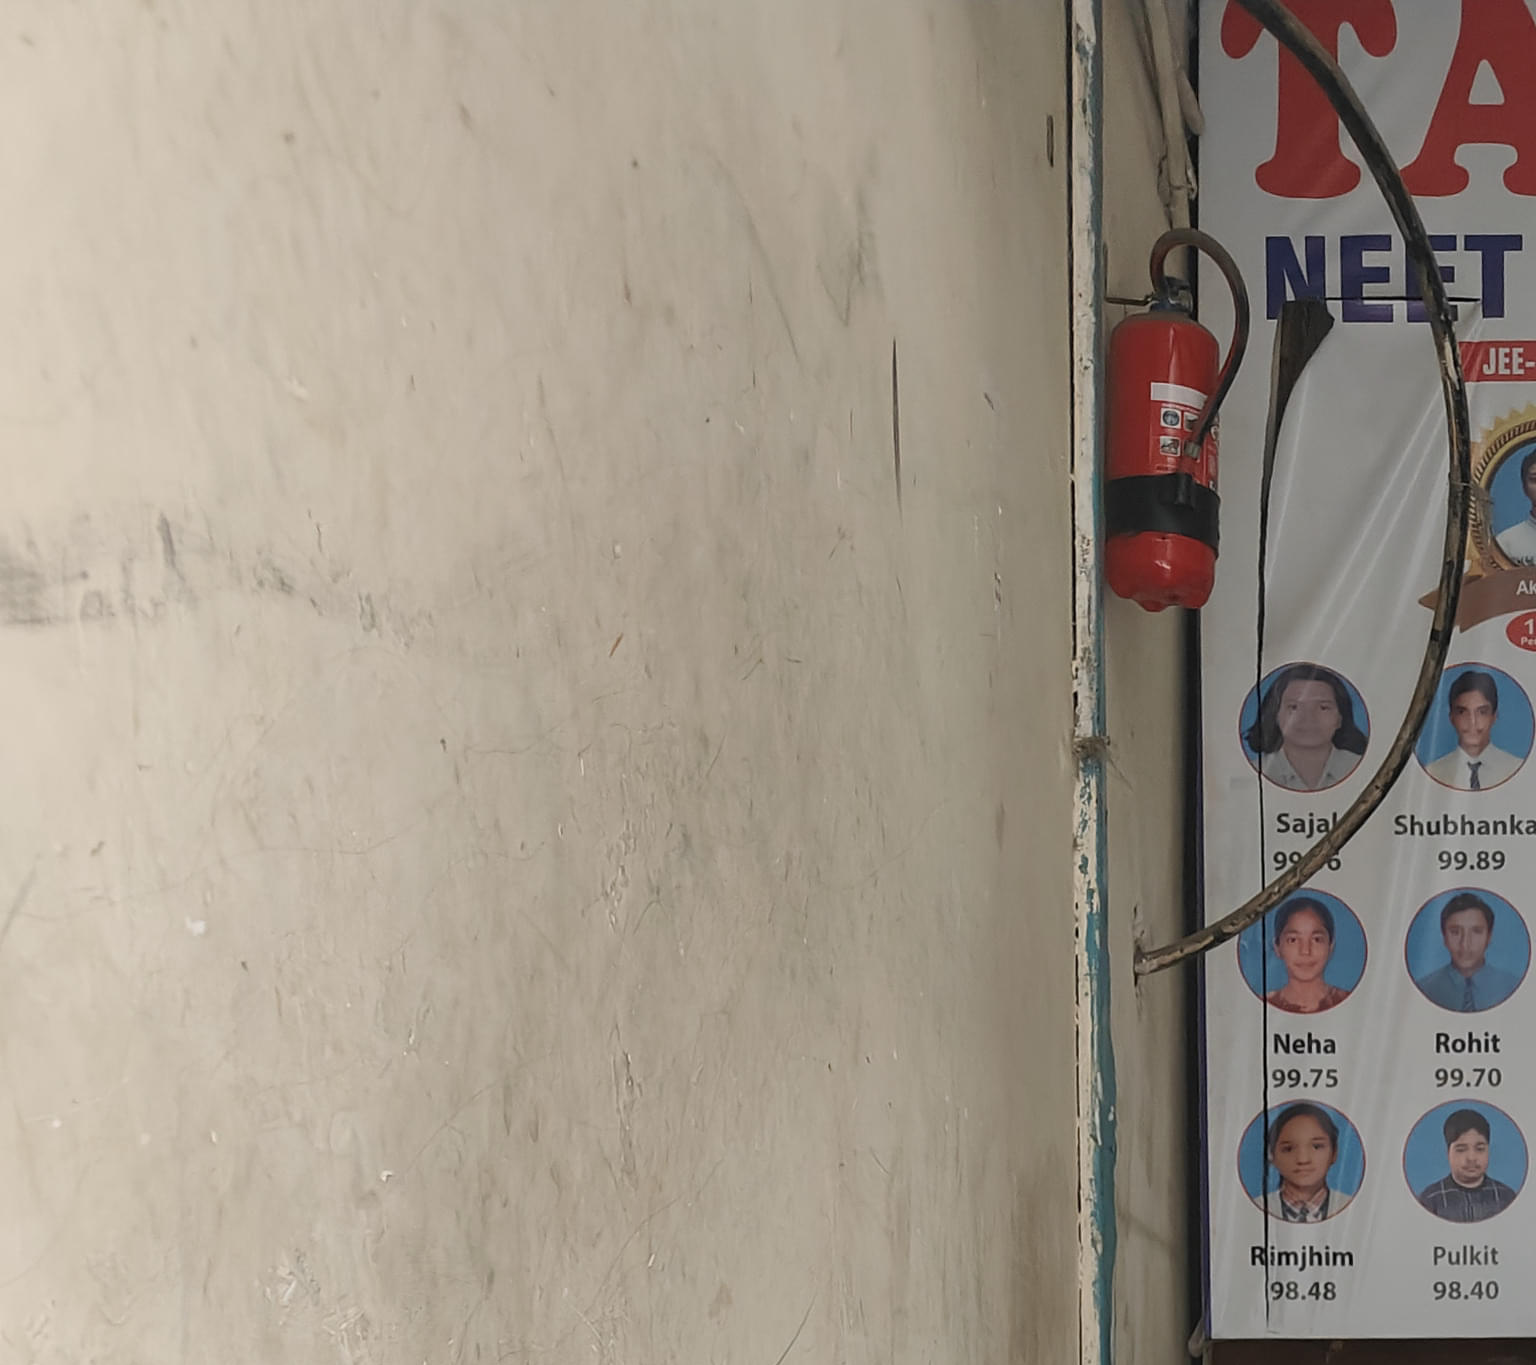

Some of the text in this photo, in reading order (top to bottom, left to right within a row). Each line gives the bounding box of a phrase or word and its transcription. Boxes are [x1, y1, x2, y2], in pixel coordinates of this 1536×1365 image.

[1264, 233, 1523, 324] NEET
[1277, 811, 1337, 839] Sajal
[1438, 850, 1506, 871] 99.89
[1273, 1033, 1336, 1054] Neha
[1435, 1032, 1500, 1053] Rohit
[1271, 1068, 1338, 1088] 99.75
[1435, 1068, 1502, 1088] 99.70
[1251, 1246, 1354, 1270] Rimjhim
[1433, 1246, 1499, 1266] Pulkit
[1271, 1281, 1337, 1301] 98.48
[1433, 1281, 1499, 1300] 98.40
